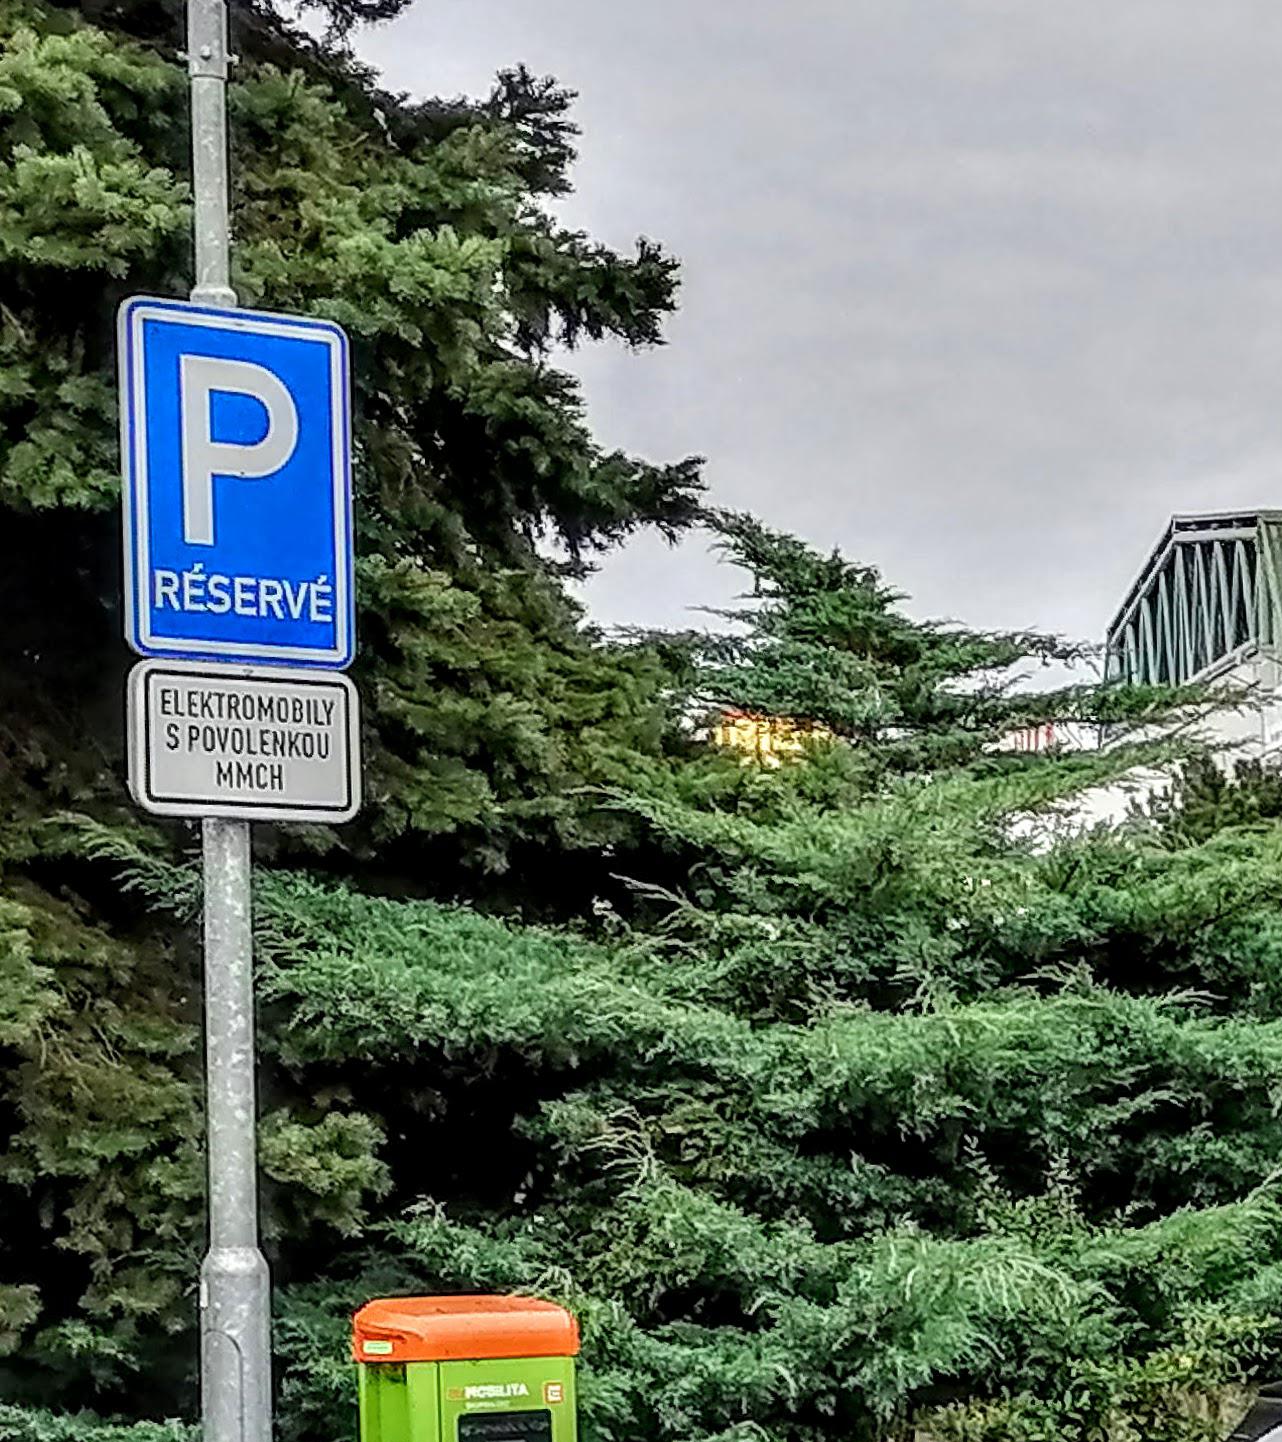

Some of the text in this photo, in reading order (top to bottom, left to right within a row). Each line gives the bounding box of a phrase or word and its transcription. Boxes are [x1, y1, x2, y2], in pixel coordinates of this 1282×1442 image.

[179, 353, 300, 546] P
[154, 563, 333, 623] RÉSERVÉ
[160, 688, 335, 727] ELEKTROMOBILY
[166, 723, 330, 759] S POVOLENKOU
[215, 760, 284, 791] MMCH
